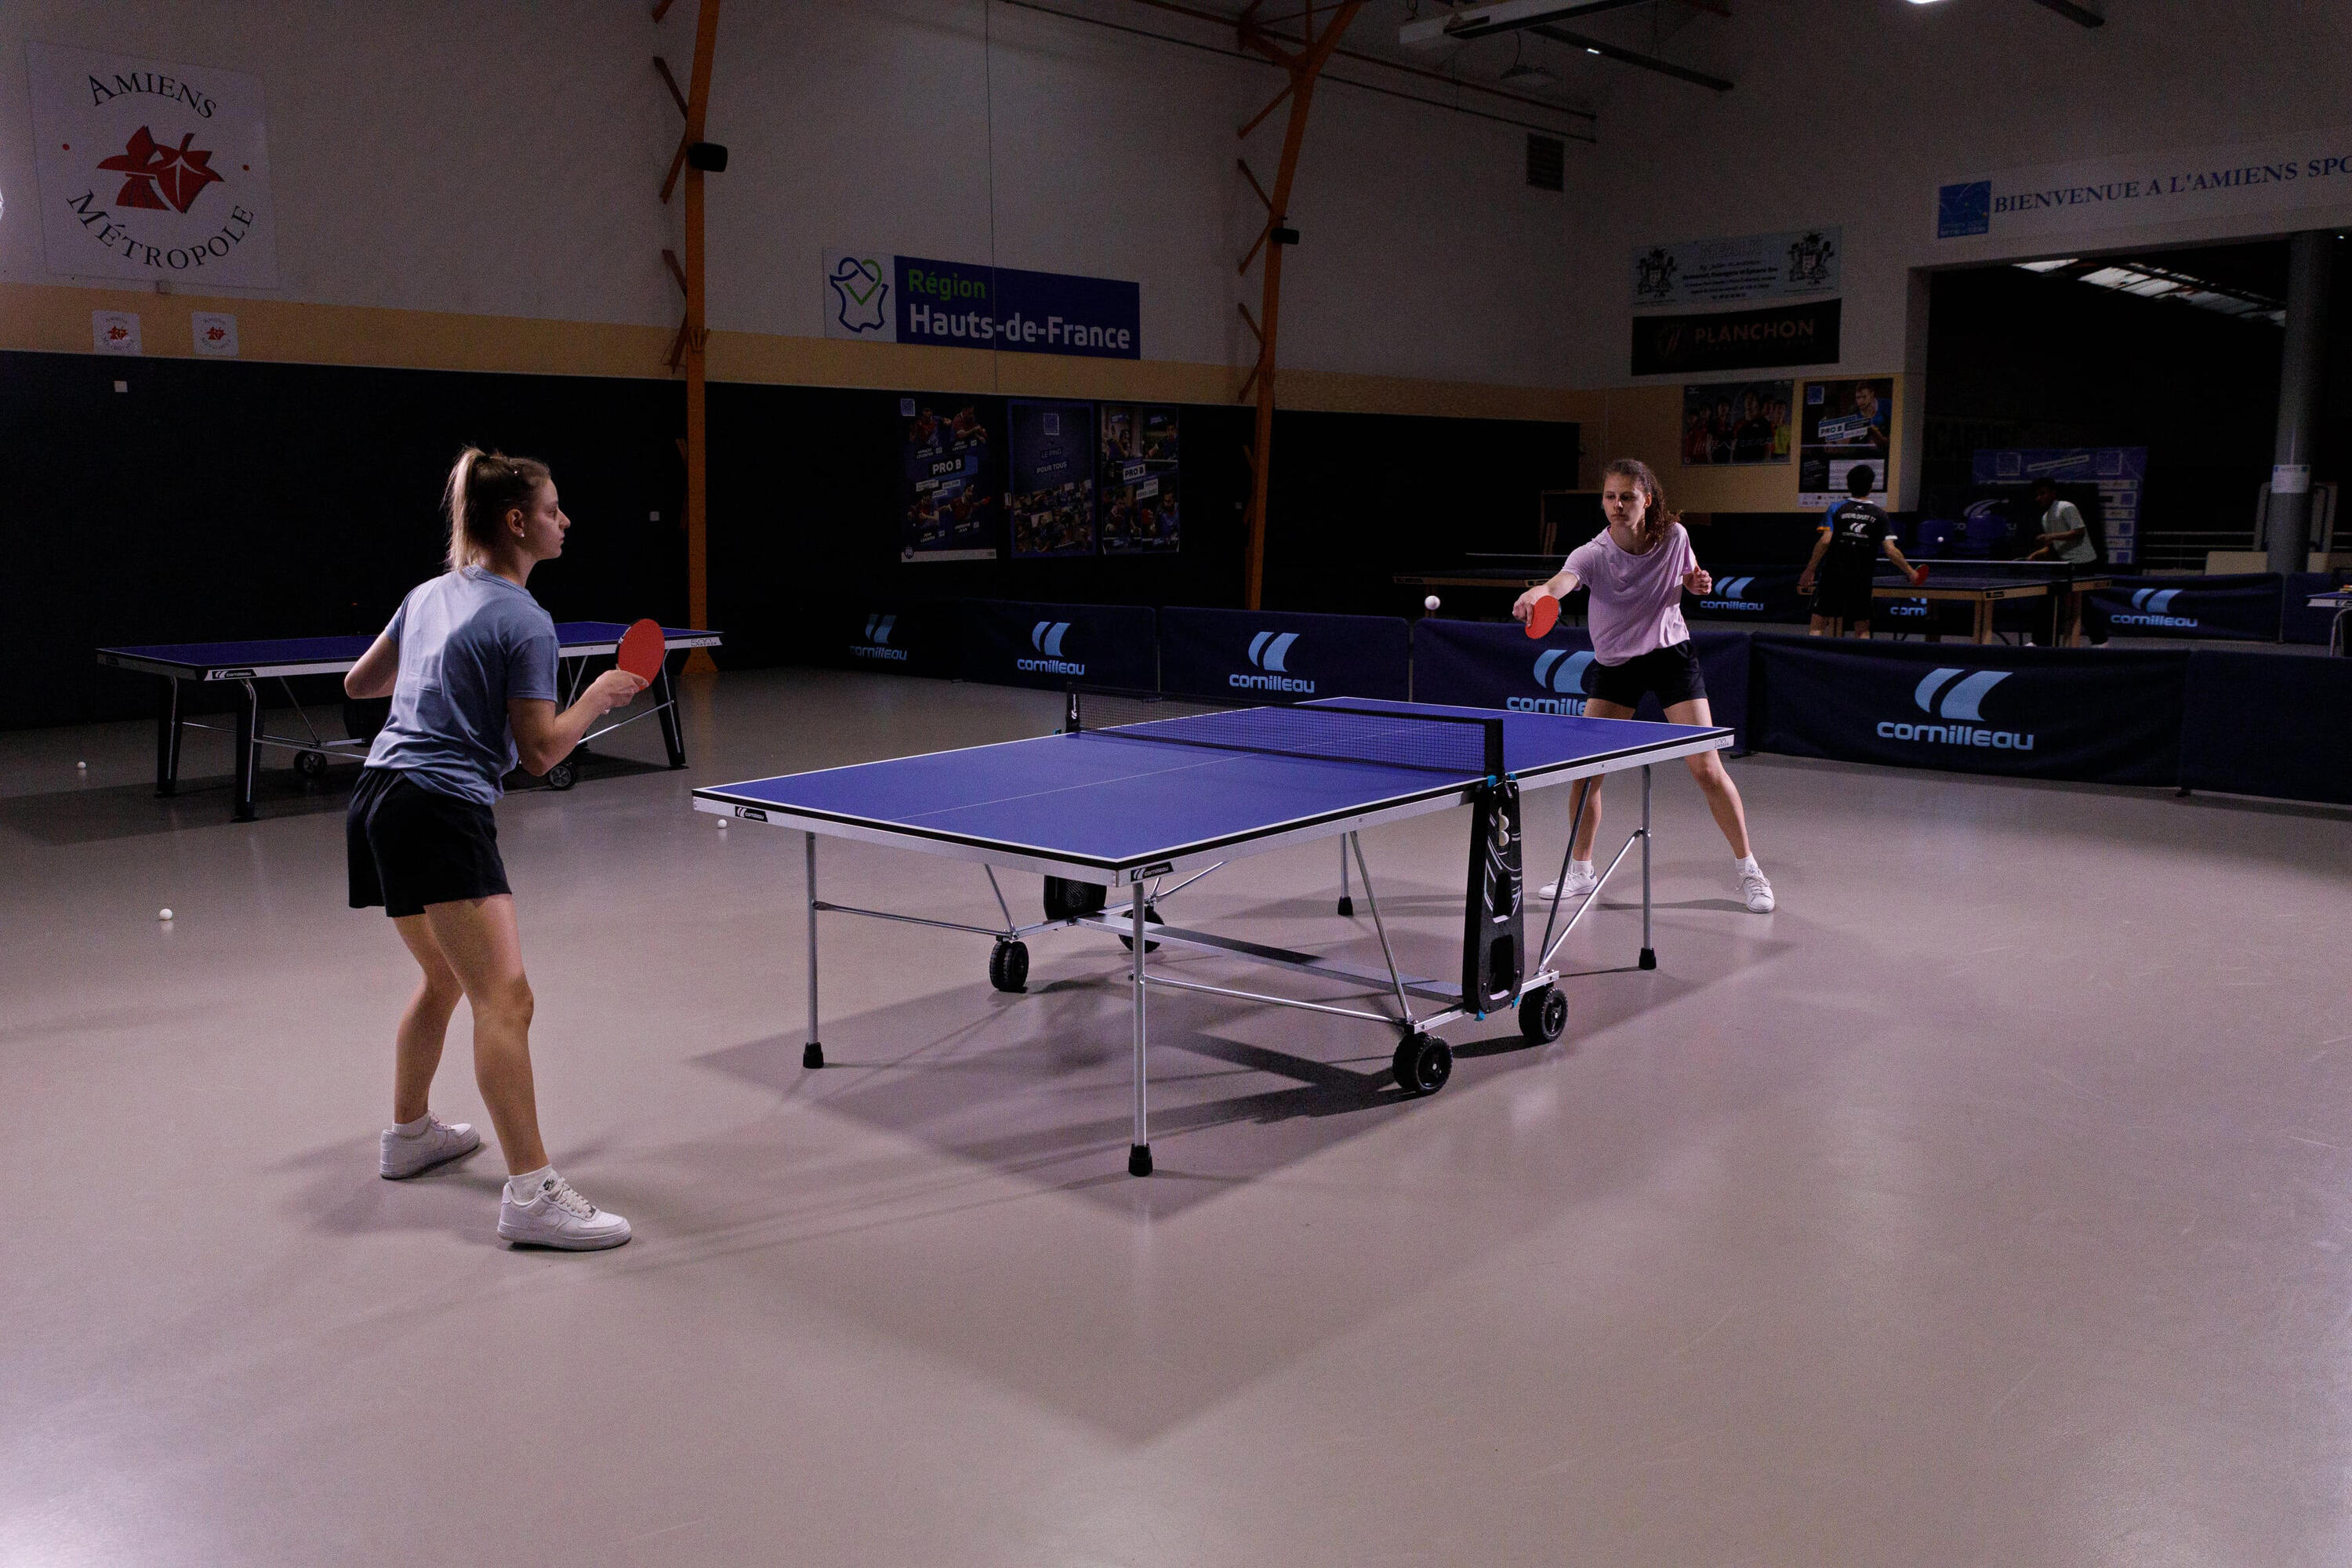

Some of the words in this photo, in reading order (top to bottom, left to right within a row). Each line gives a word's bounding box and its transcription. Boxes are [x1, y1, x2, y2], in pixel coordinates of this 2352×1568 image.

[88, 72, 217, 119] AMIENS
[1994, 181, 2140, 213] BIENVENUE
[2147, 179, 2161, 196] A
[2169, 162, 2298, 193] L'AMIENS
[67, 189, 254, 270] MÉTROPOLE
[908, 269, 985, 301] Région
[909, 303, 1131, 350] Hauts-de-France
[1693, 319, 1813, 343] PLANCHON
[932, 460, 954, 475] PRO
[955, 459, 962, 470] B
[1124, 468, 1138, 477] PRO
[1700, 601, 1764, 611] cornilleau
[2110, 614, 2198, 627] cornilleau
[1017, 659, 1085, 676] cornilleau
[1229, 673, 1316, 694] cornilleau
[1876, 721, 2035, 751] cornilleau
